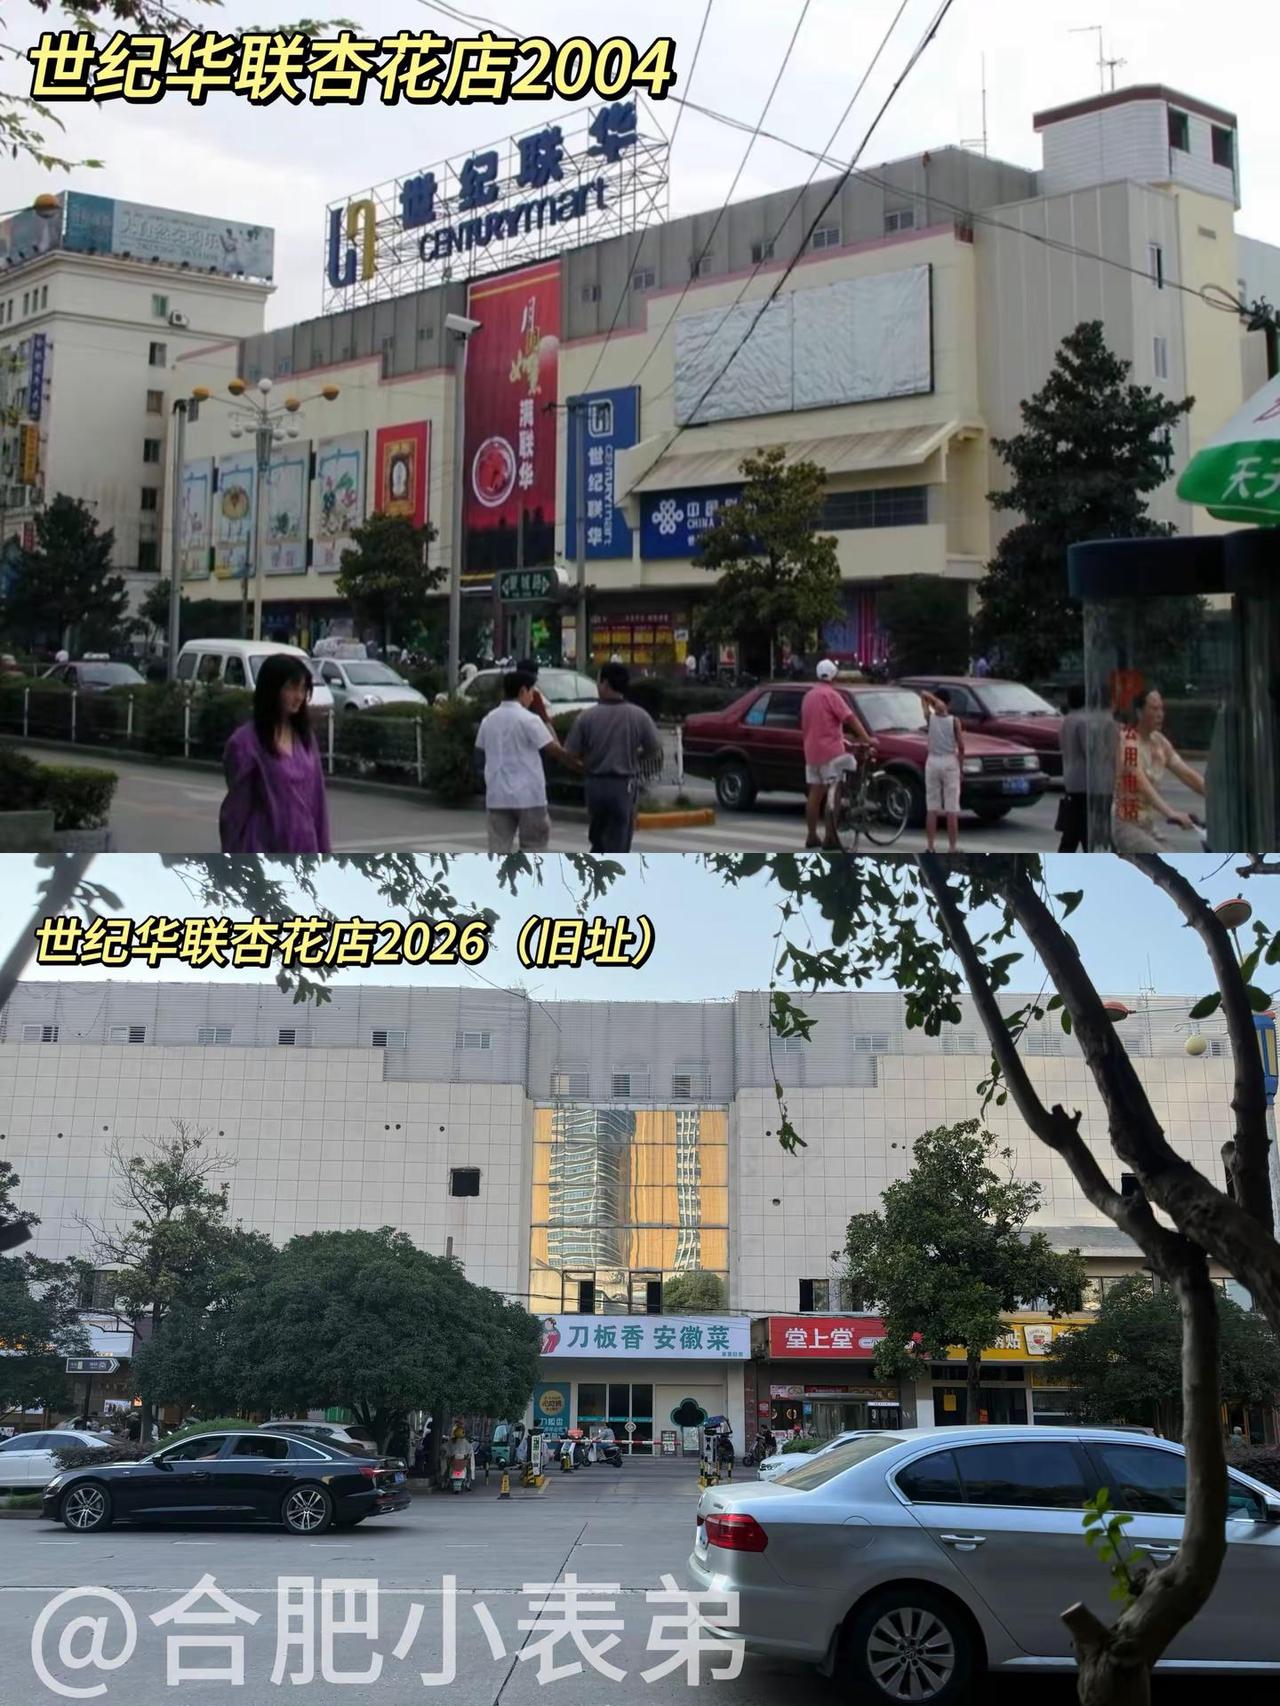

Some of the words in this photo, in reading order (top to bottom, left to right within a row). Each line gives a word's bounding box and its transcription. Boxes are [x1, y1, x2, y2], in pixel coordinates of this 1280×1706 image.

[400, 101, 638, 230] 世纪联华
[418, 176, 608, 262] CENTURYmart
[587, 445, 604, 547] 世纪联华
[567, 1324, 645, 1351] 刀板香
[653, 1324, 731, 1351] 安徽菜
[785, 1327, 854, 1349] 堂上堂
